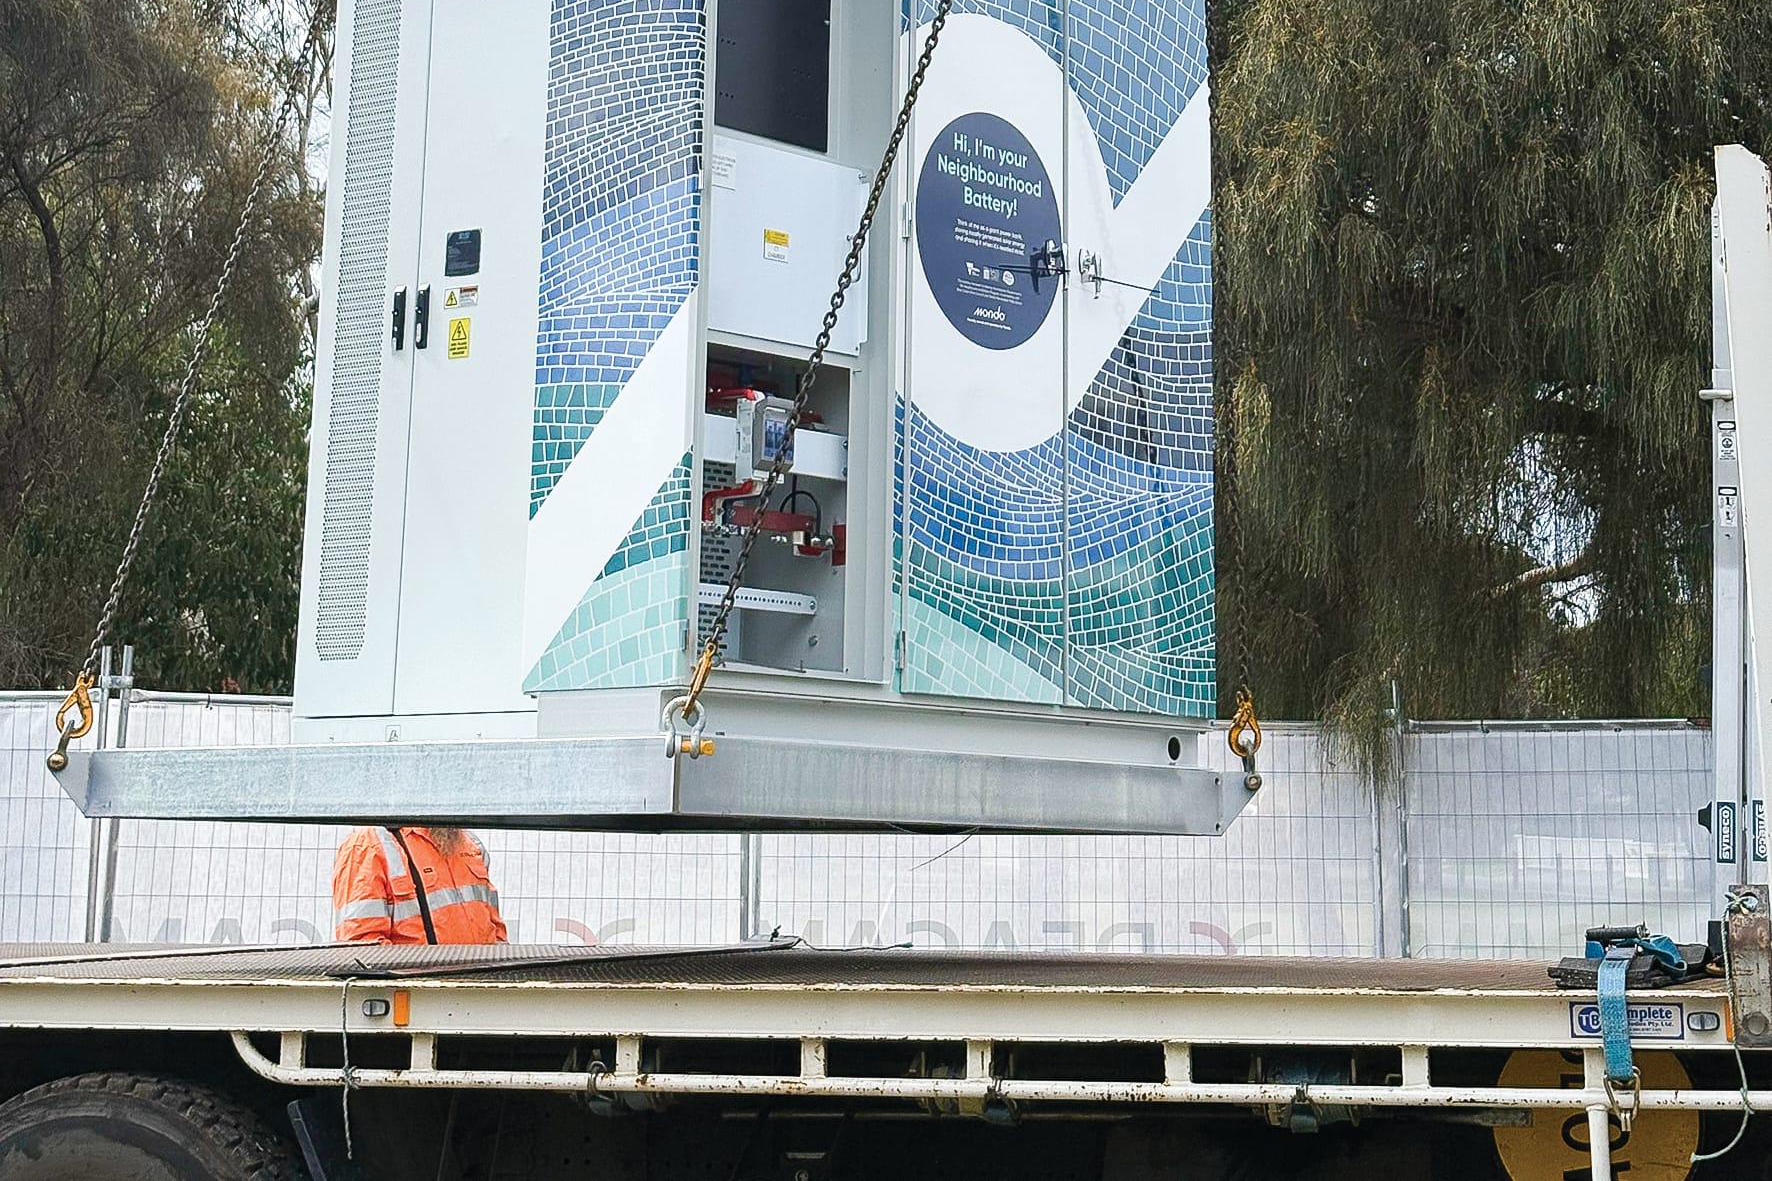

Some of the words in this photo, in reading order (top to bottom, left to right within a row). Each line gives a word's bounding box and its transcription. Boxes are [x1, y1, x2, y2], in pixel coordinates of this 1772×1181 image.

[954, 132, 971, 157] Hi,
[975, 138, 995, 160] I'm
[998, 149, 1028, 169] your
[938, 153, 1042, 198] Neighbourhood
[964, 185, 1017, 219] Battery!
[1627, 1007, 1672, 1022] mplete
